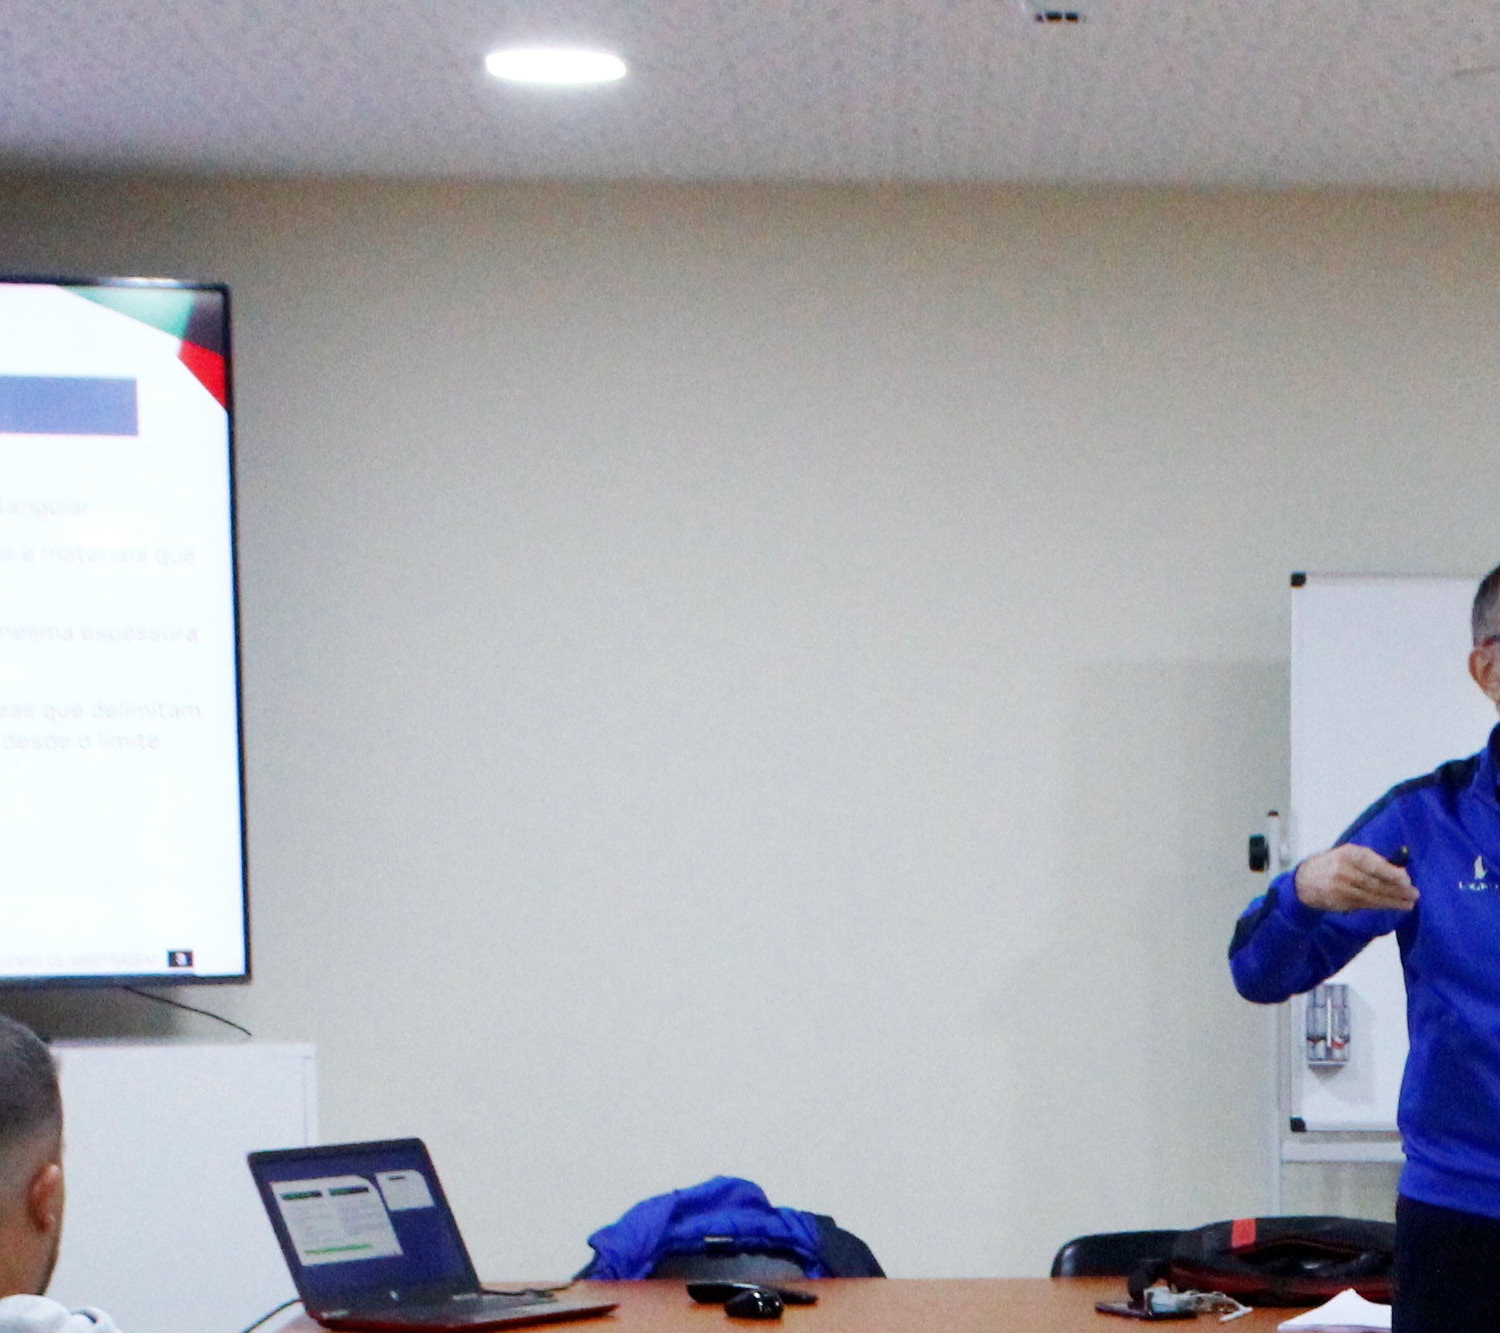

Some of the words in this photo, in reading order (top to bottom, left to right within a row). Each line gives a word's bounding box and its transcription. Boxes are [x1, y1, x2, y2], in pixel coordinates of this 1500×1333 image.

[153, 547, 198, 568] que
[80, 624, 199, 647] espessura
[44, 704, 84, 723] que
[90, 700, 203, 720] delimitam
[2, 732, 73, 752] desde
